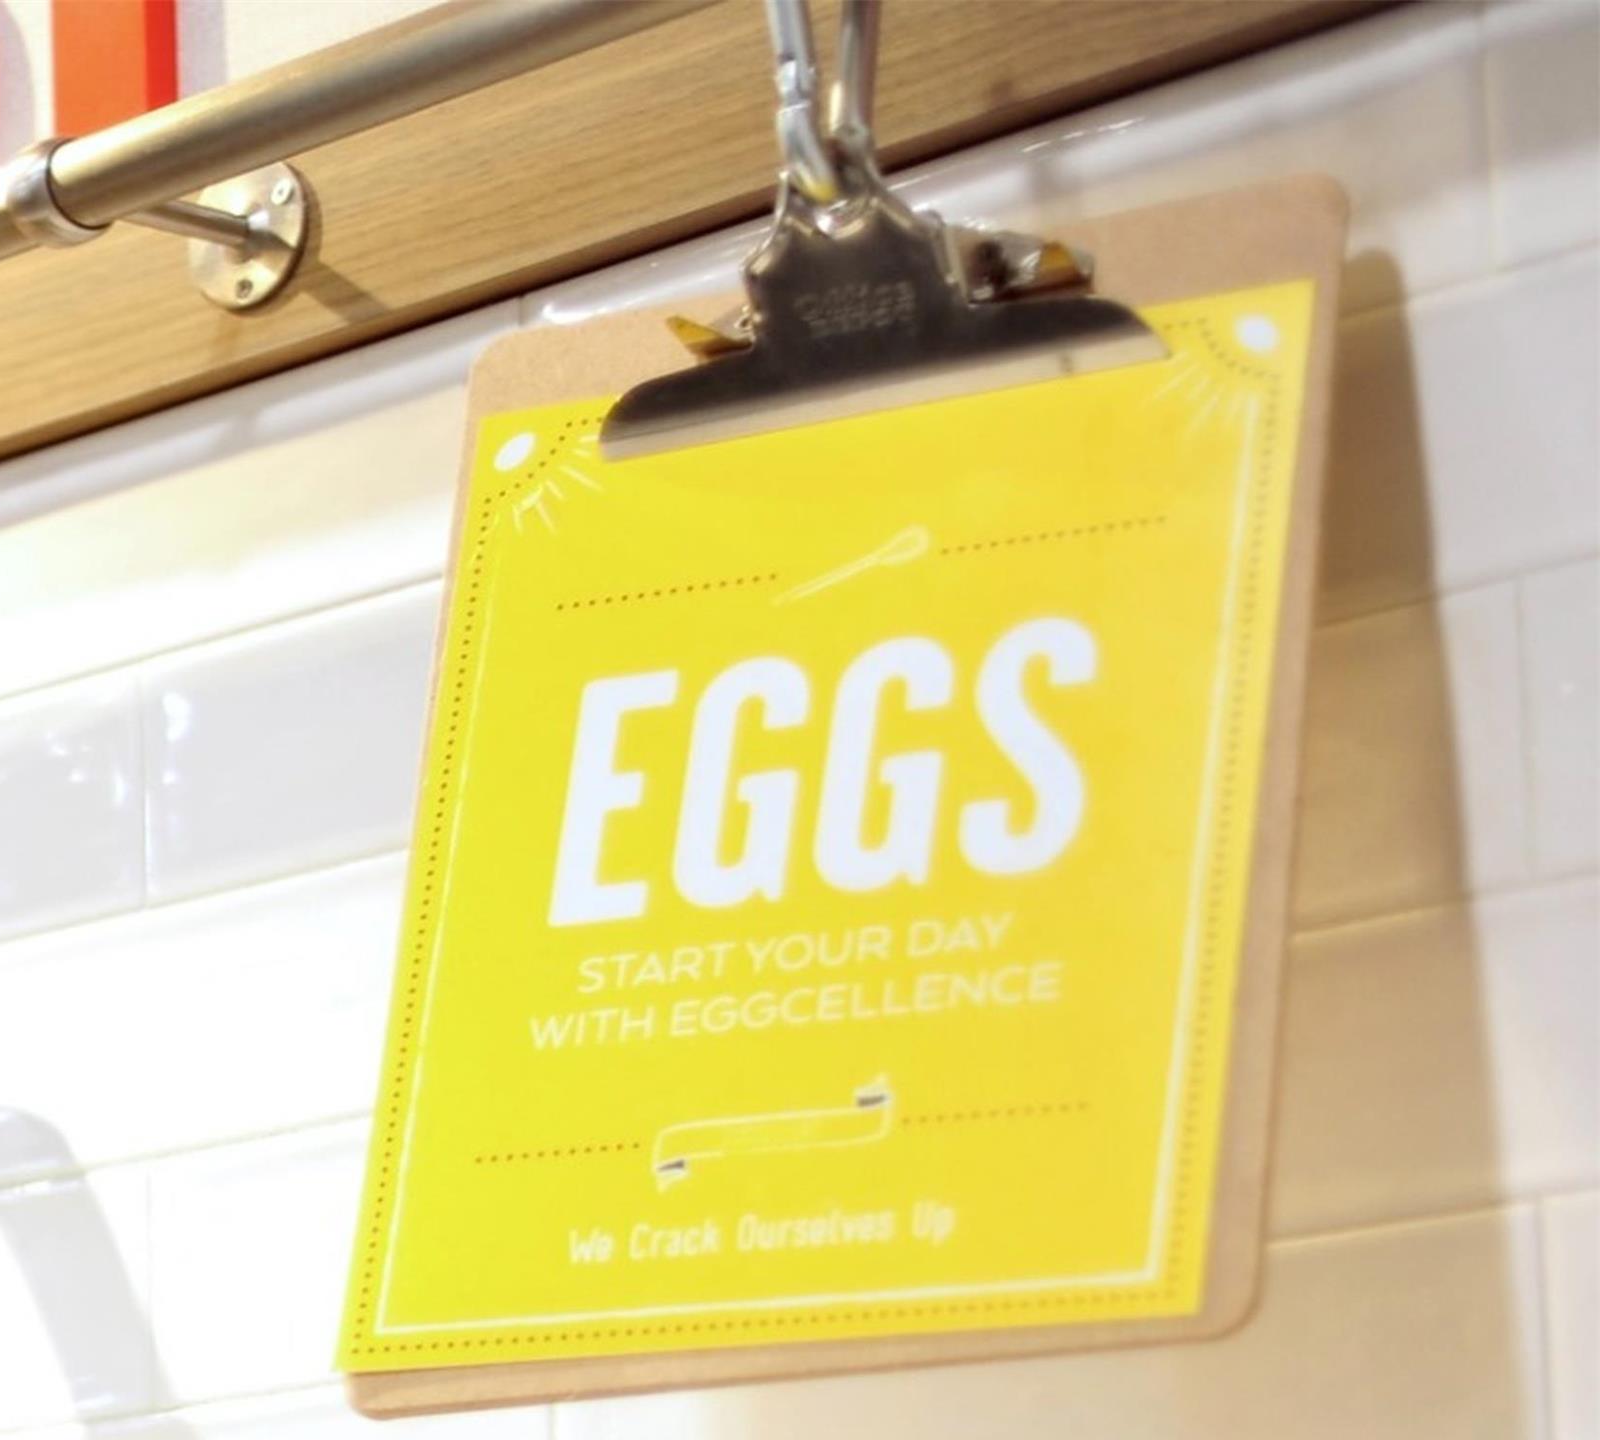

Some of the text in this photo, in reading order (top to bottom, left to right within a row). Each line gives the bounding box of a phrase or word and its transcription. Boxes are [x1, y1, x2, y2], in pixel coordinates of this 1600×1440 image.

[547, 616, 1098, 927] EGGS
[578, 911, 1014, 994] START YOUR DAY
[529, 960, 1065, 1051] WITH EGGCELLENCE
[568, 1200, 957, 1266] We Crack Ourselves Up
